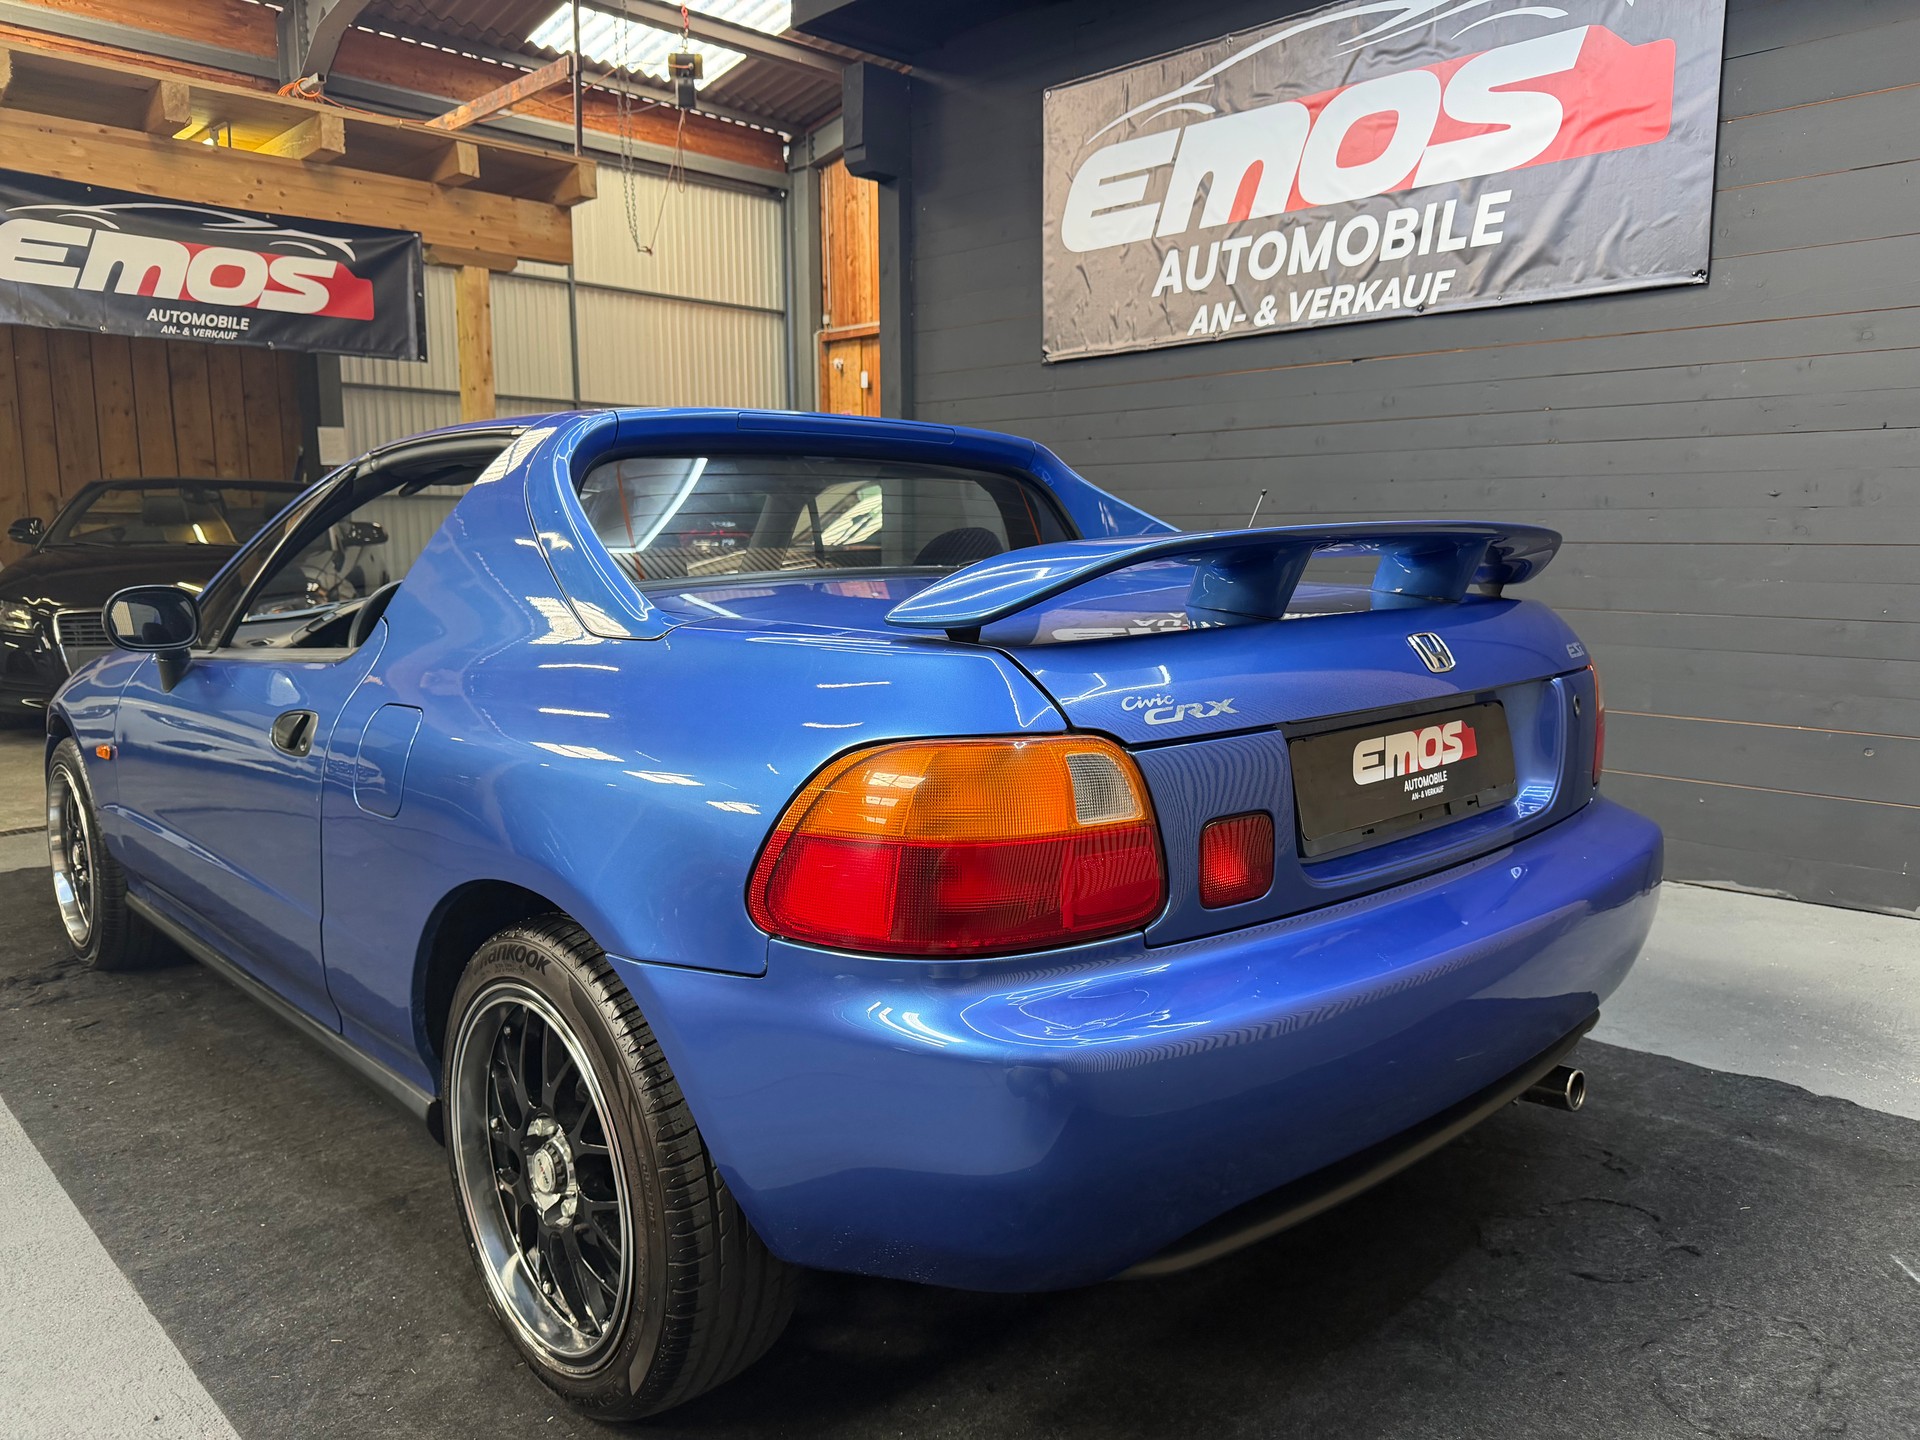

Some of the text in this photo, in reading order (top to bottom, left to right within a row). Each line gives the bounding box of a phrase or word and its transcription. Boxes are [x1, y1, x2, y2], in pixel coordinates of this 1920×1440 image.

[1151, 190, 1512, 297] AUTOMOBILE
[1187, 269, 1457, 336] AN- & VERKAUF
[146, 308, 250, 331] AUTOMOBILE
[160, 325, 239, 340] AN- & VERKAUF
[1121, 693, 1175, 711] Civic
[1143, 698, 1239, 725] CRX
[1404, 770, 1448, 792] AUTOMOBILE
